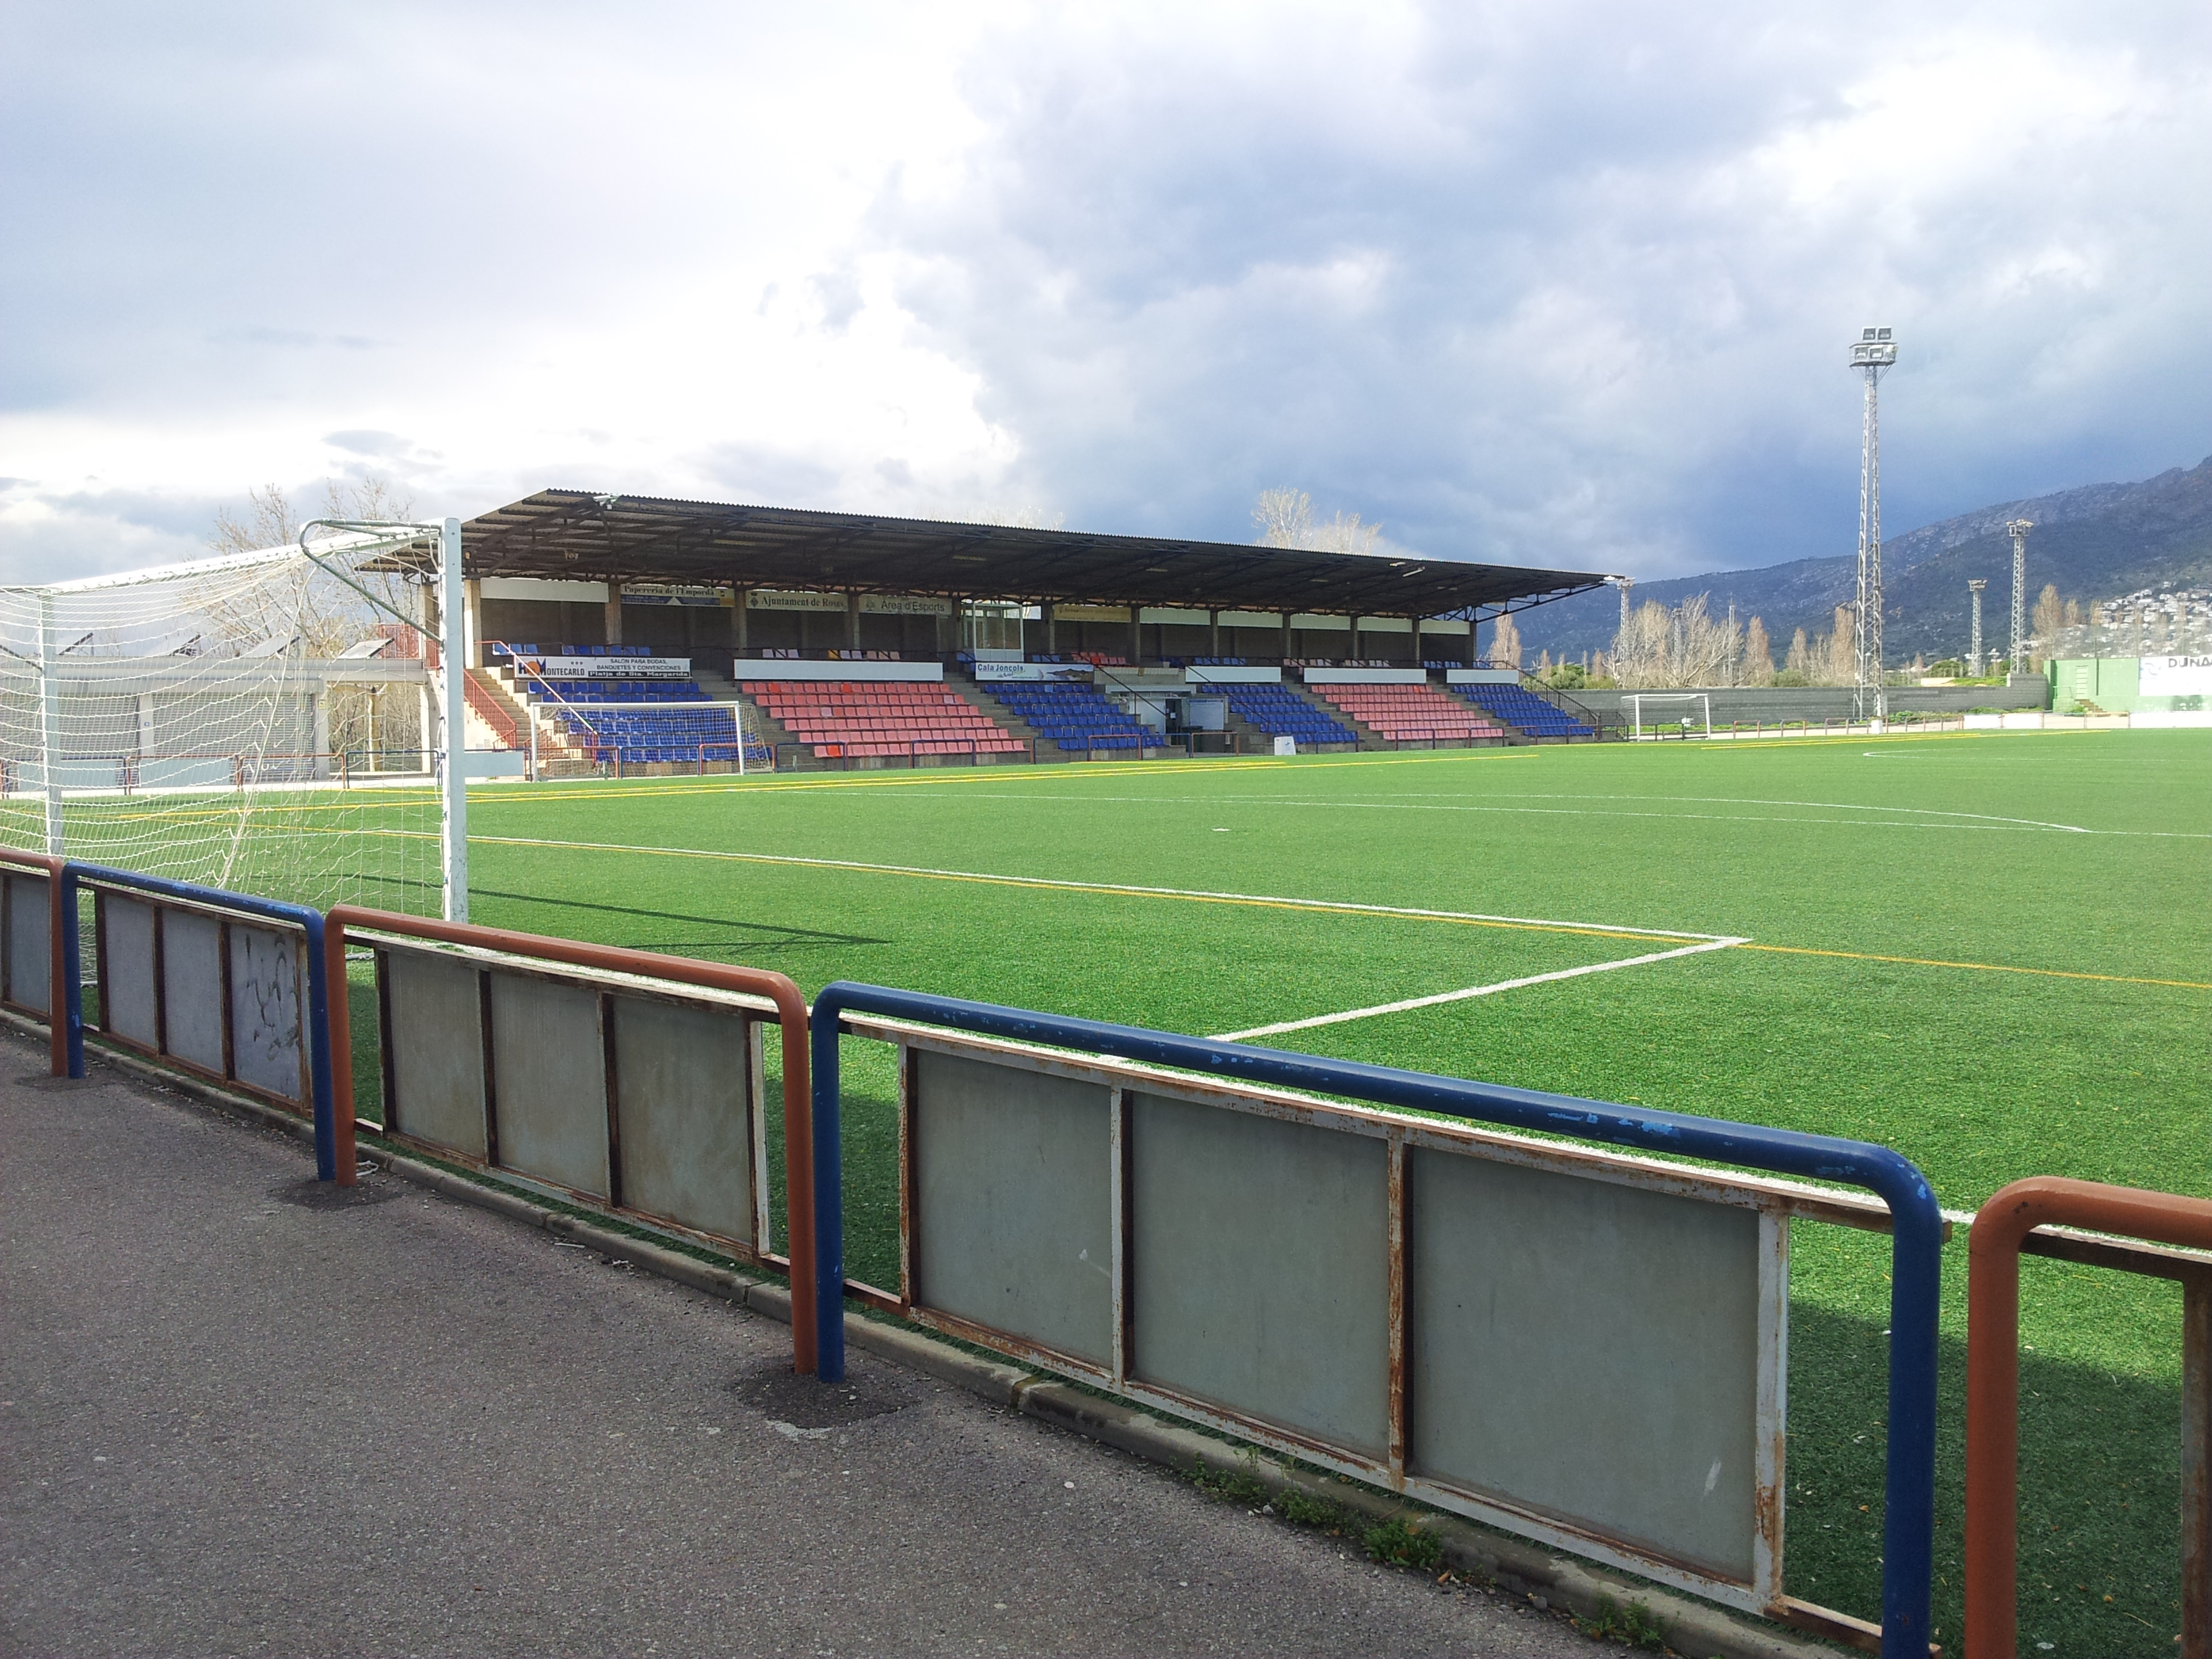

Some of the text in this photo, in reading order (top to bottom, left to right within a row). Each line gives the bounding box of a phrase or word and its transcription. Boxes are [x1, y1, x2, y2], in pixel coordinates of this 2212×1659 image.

[761, 596, 844, 607] Ajuntament de Roses
[905, 600, 945, 612] d'Esports
[2168, 657, 2212, 668] DUNA
